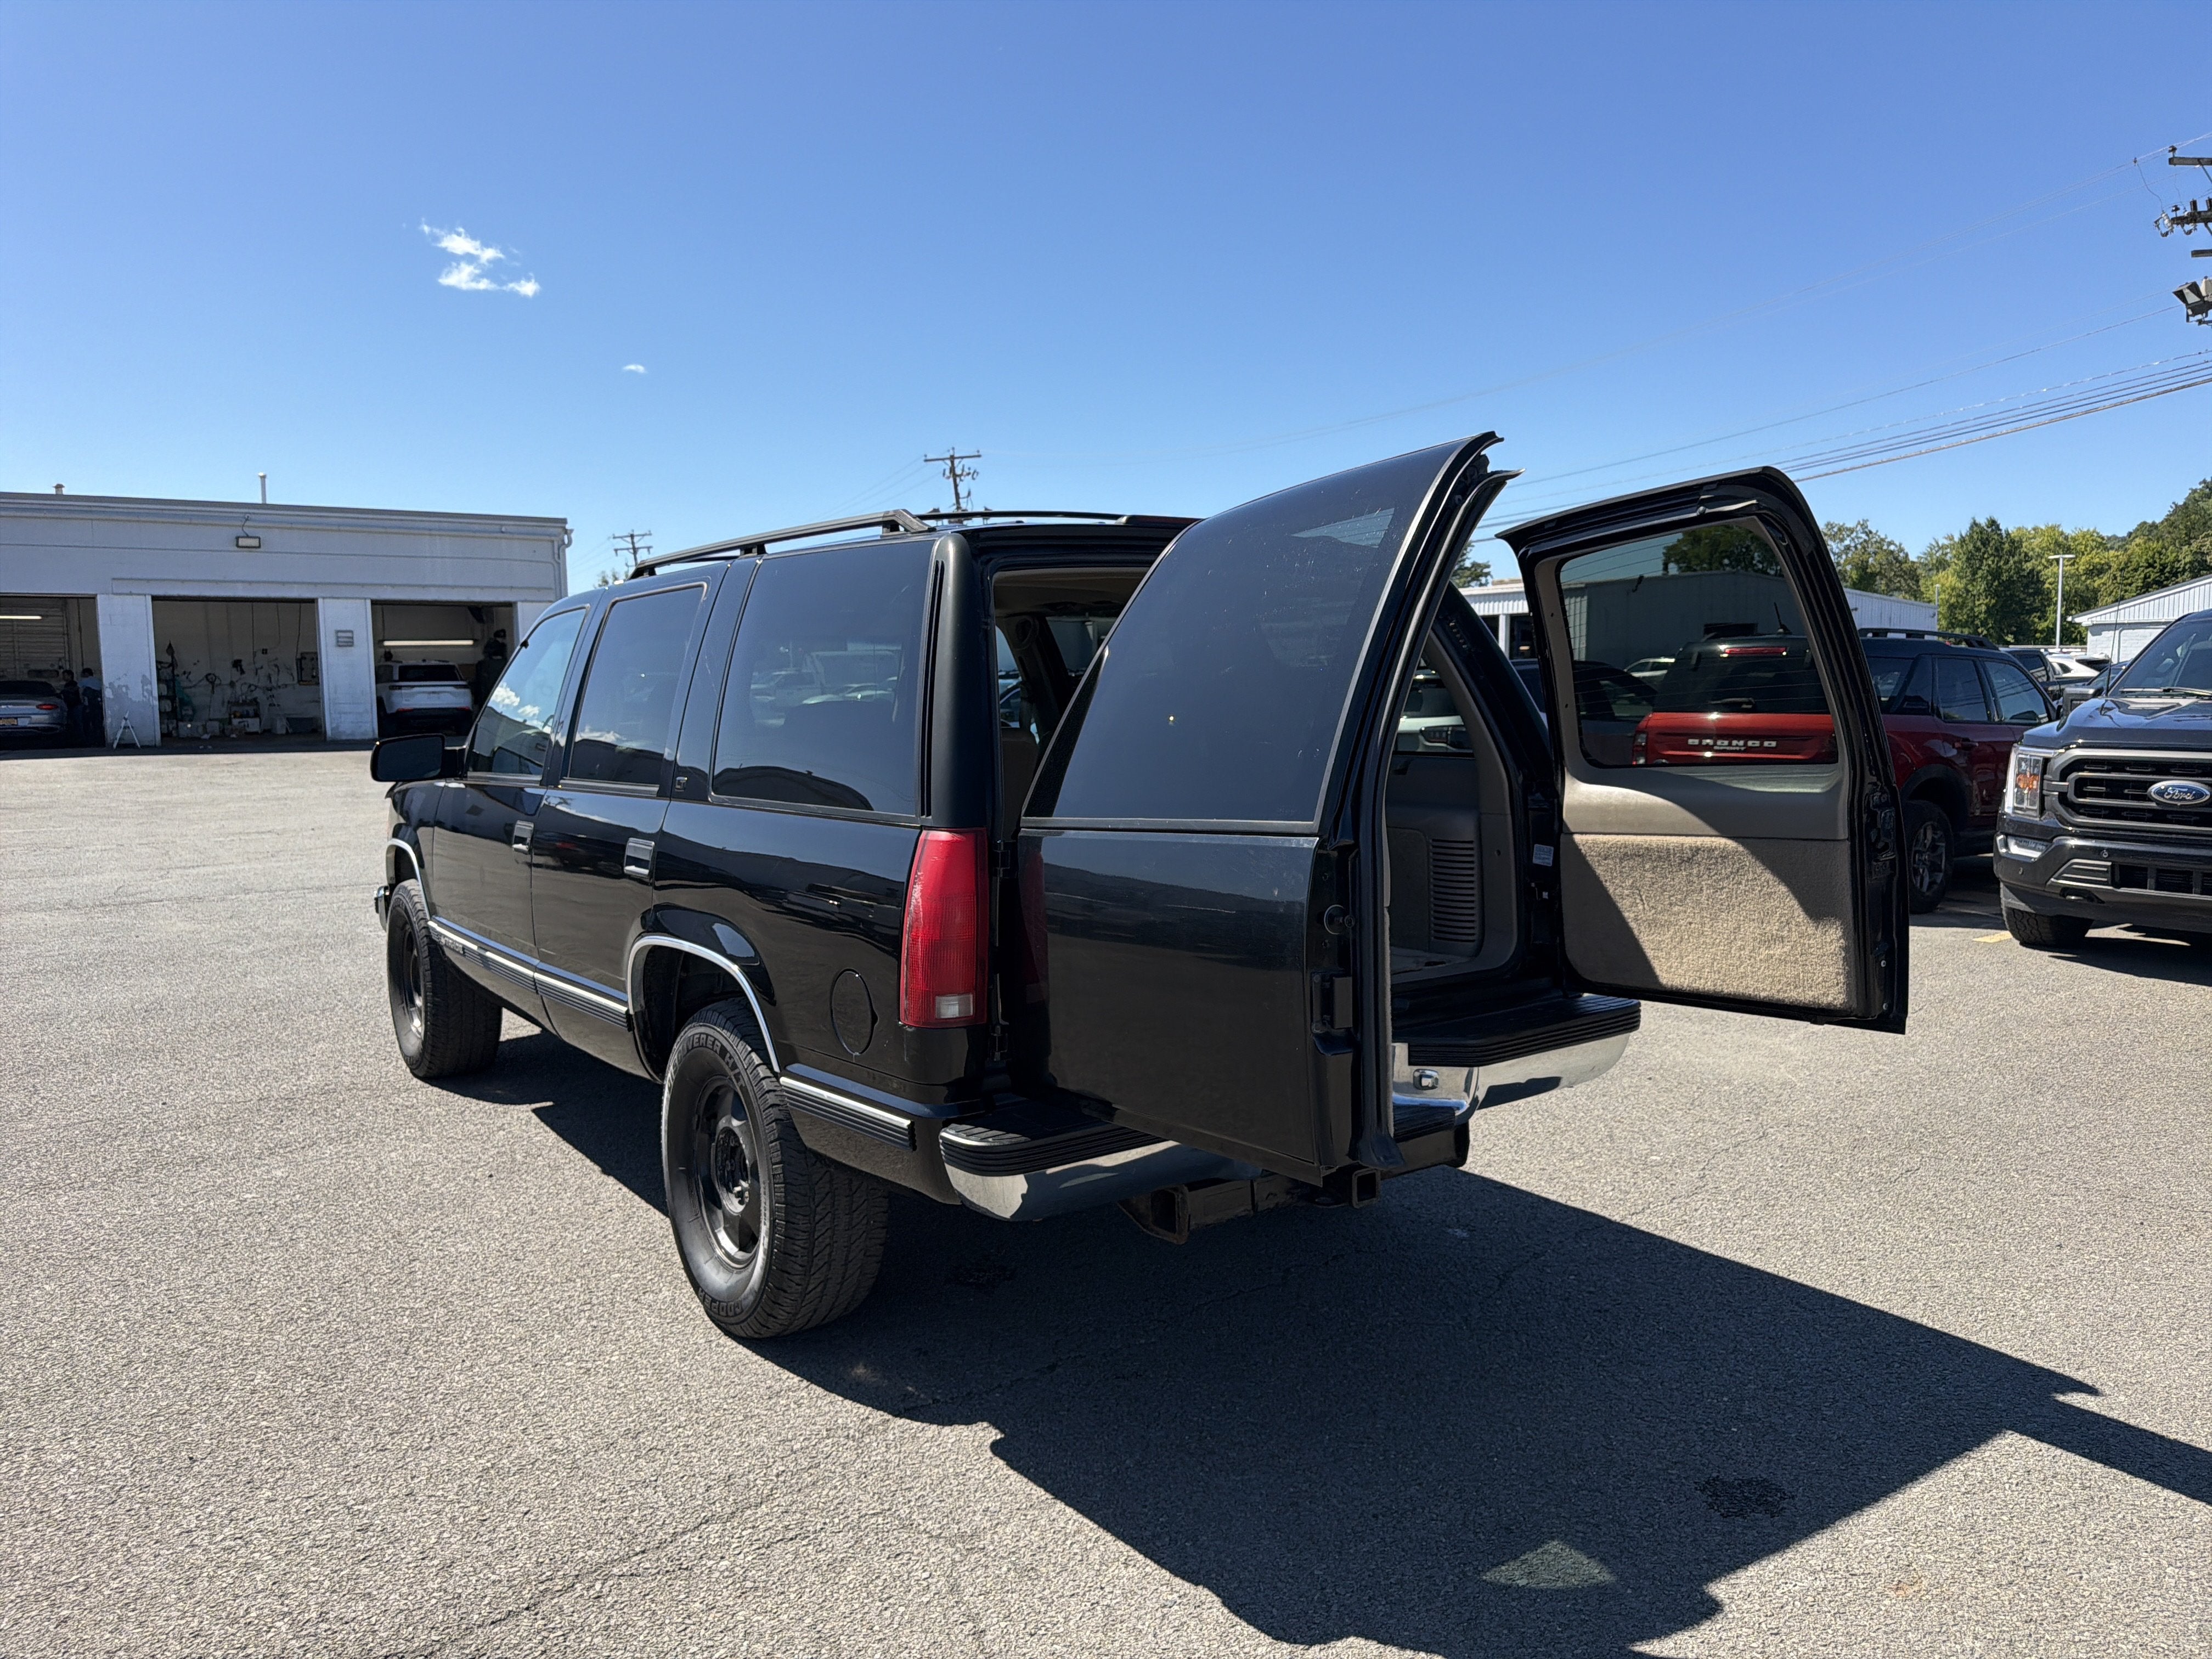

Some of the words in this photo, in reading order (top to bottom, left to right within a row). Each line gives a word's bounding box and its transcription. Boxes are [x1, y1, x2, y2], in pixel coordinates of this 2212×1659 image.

[1688, 738, 1777, 748] BRONCO
[2164, 787, 2196, 800] Ford
[698, 1286, 742, 1316] COOPER
